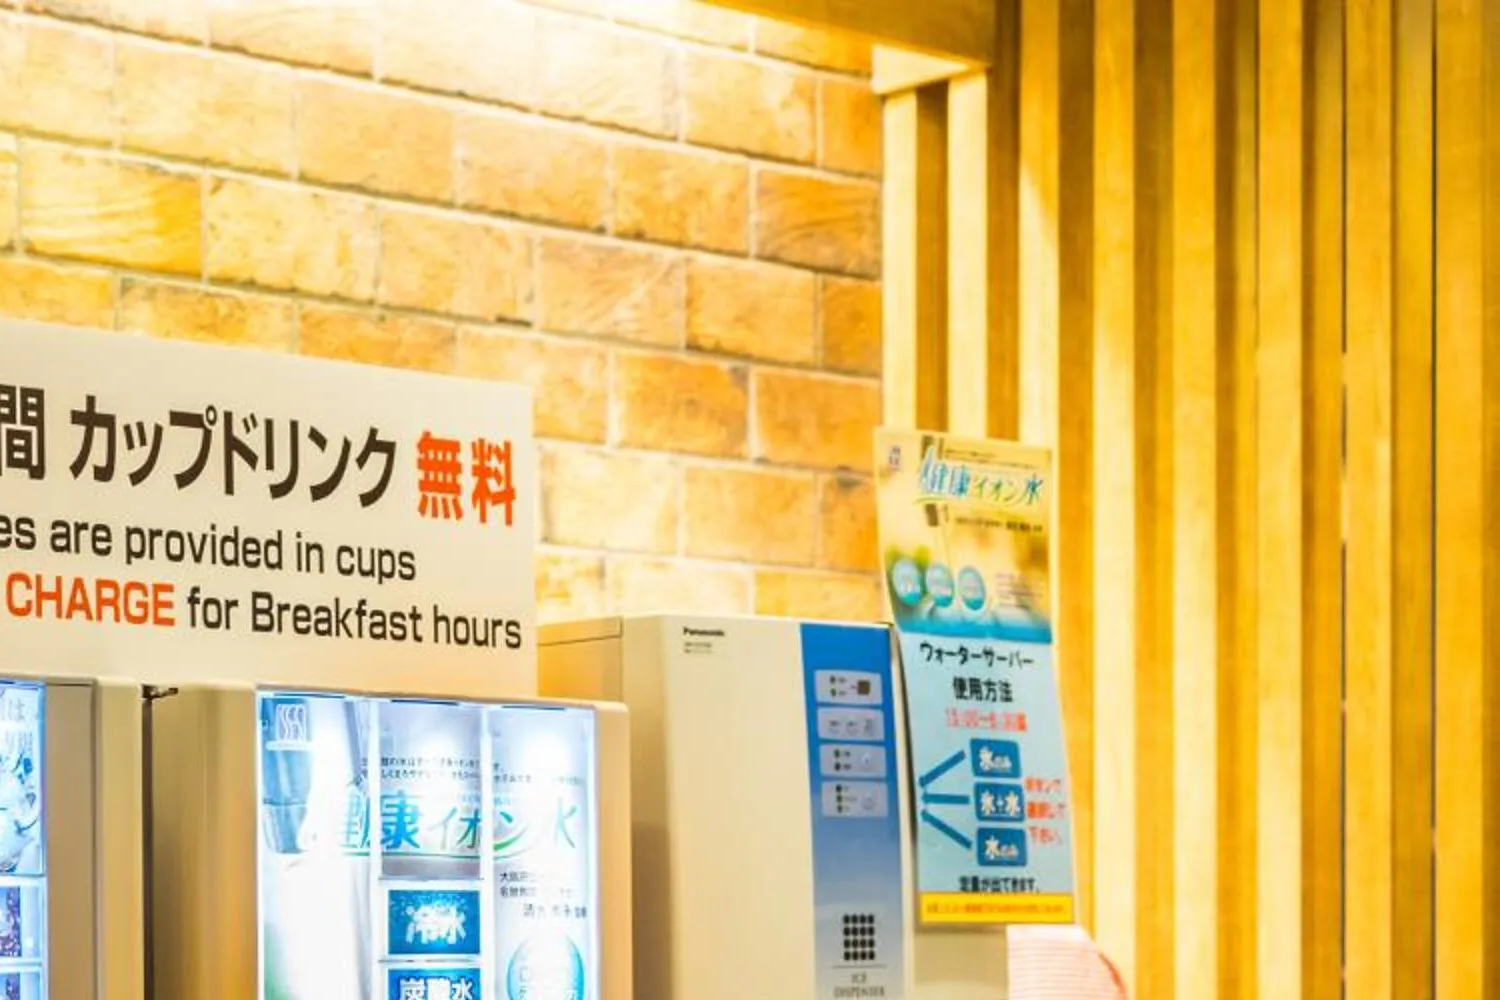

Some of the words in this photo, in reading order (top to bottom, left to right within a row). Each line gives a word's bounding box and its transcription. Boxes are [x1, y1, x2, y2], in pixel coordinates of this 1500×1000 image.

[68, 394, 397, 508] カップドリンク
[416, 430, 517, 527] 無料
[49, 517, 112, 556] are
[125, 520, 284, 571] provided
[296, 531, 325, 573] in
[336, 544, 417, 584] cups
[5, 572, 176, 628] CHARGE
[187, 587, 239, 631] for
[251, 590, 423, 643] Breakfast
[433, 607, 523, 650] hours
[919, 641, 1035, 668] ウォーターサーバー
[953, 676, 1014, 703] 使用方法
